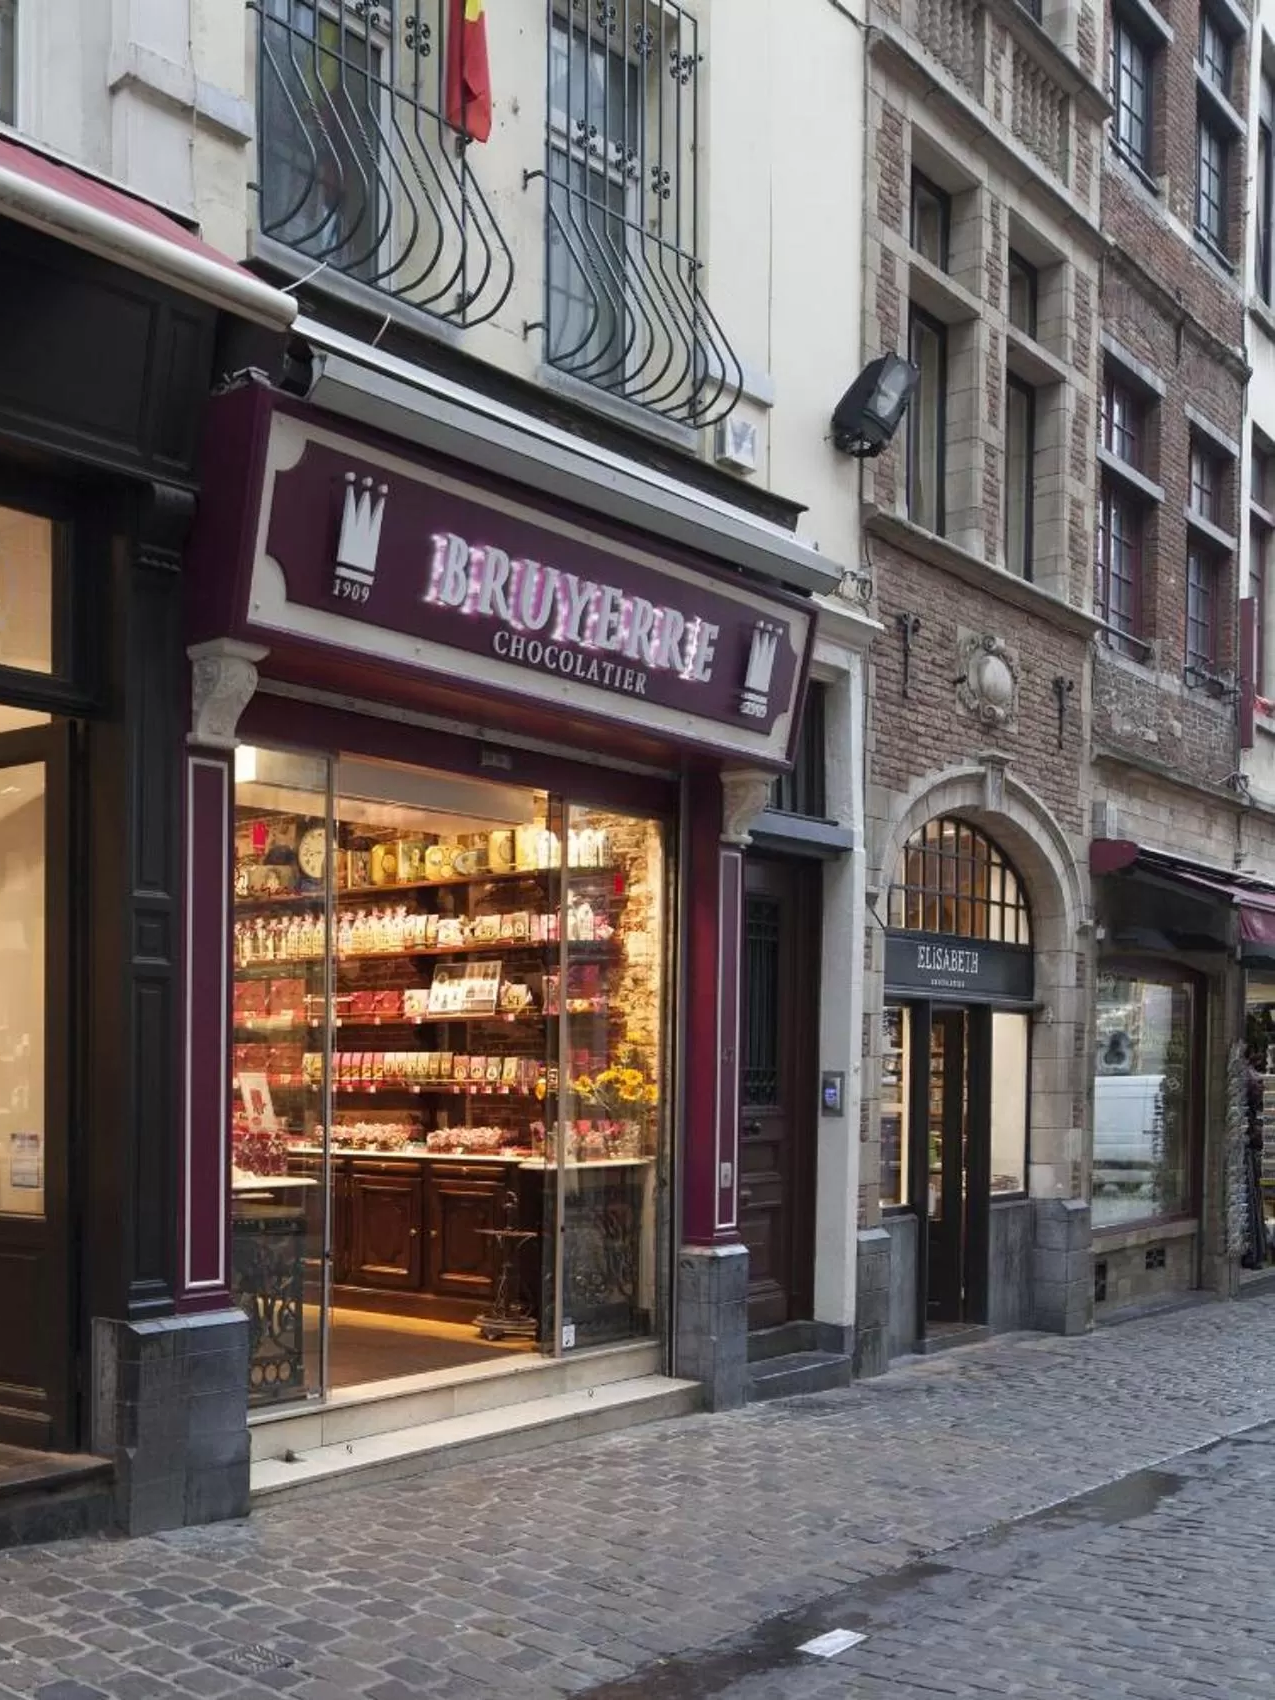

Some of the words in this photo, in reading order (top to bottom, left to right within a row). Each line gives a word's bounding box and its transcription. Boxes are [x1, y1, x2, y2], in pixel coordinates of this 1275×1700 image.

[332, 579, 370, 604] 1909
[425, 532, 720, 683] BRUYERRE
[492, 630, 647, 695] CHOCOLATIER
